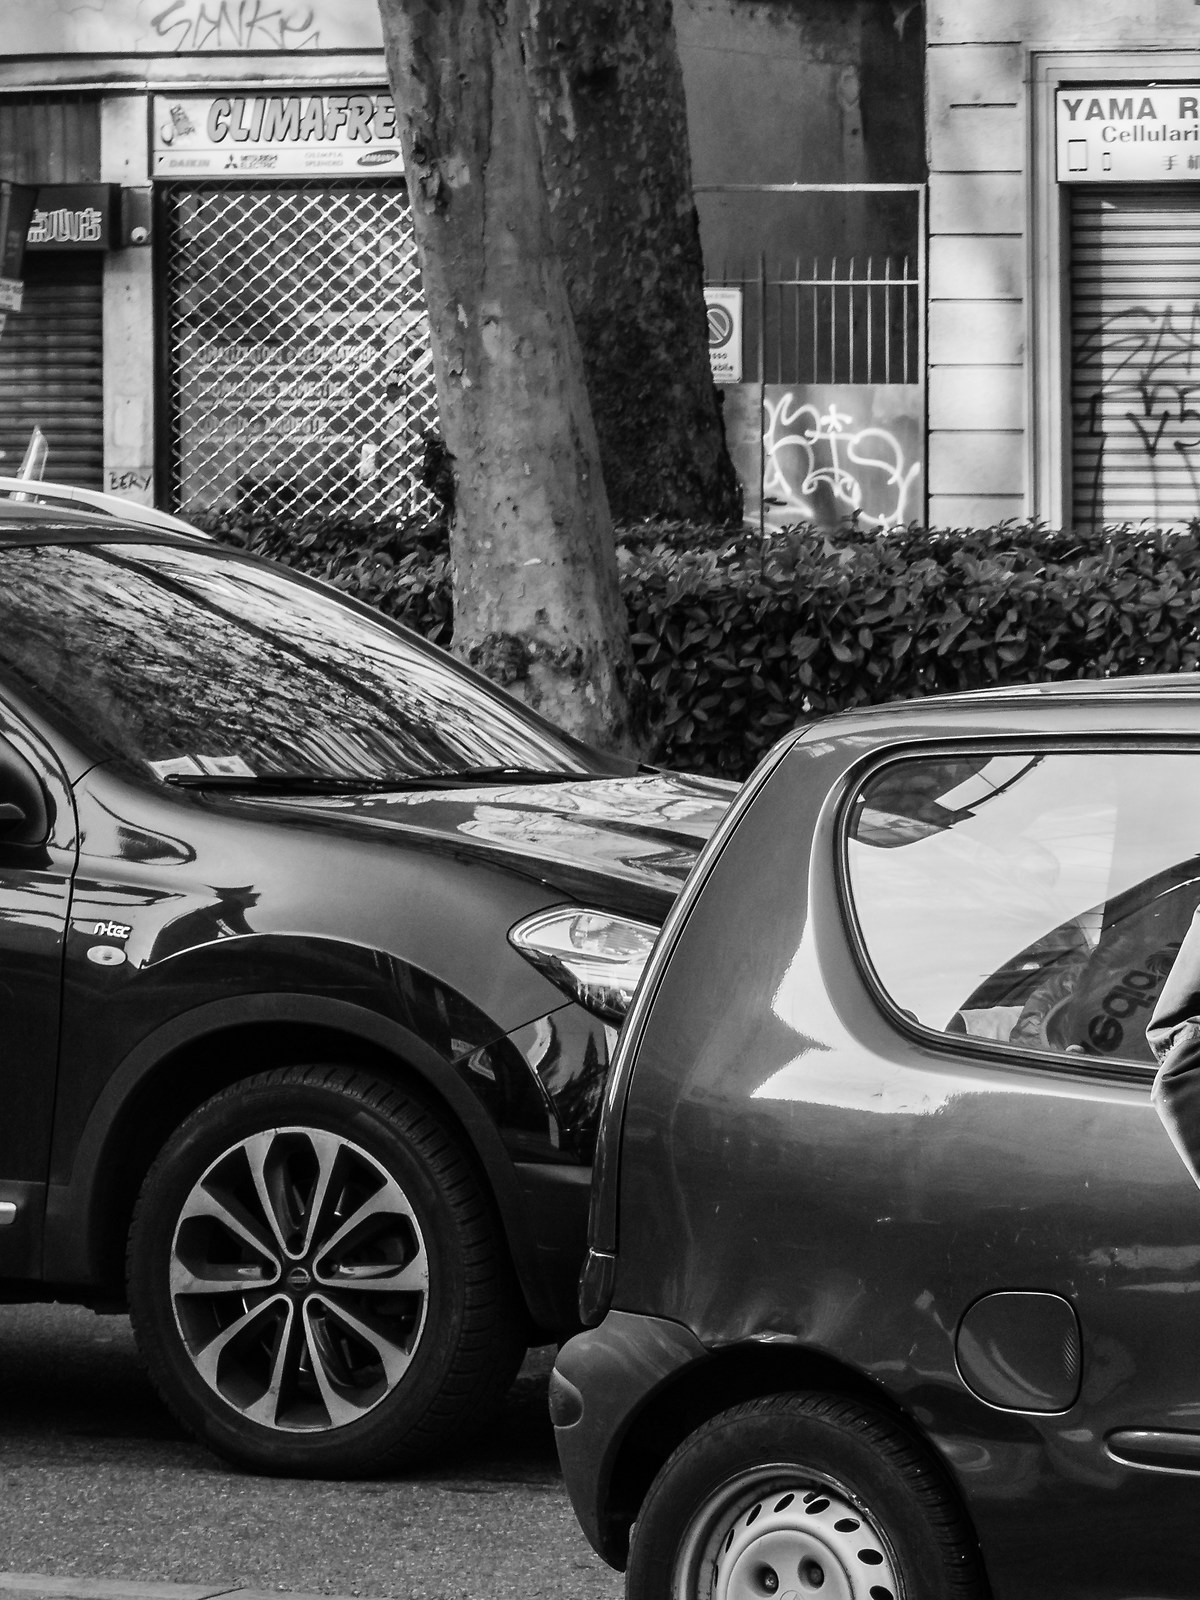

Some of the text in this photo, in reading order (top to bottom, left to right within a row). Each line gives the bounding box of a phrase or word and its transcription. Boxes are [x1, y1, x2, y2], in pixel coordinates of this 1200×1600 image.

[206, 95, 400, 144] CLIMAFRE
[1063, 98, 1158, 121] YAMA
[1102, 125, 1199, 143] Cellulari
